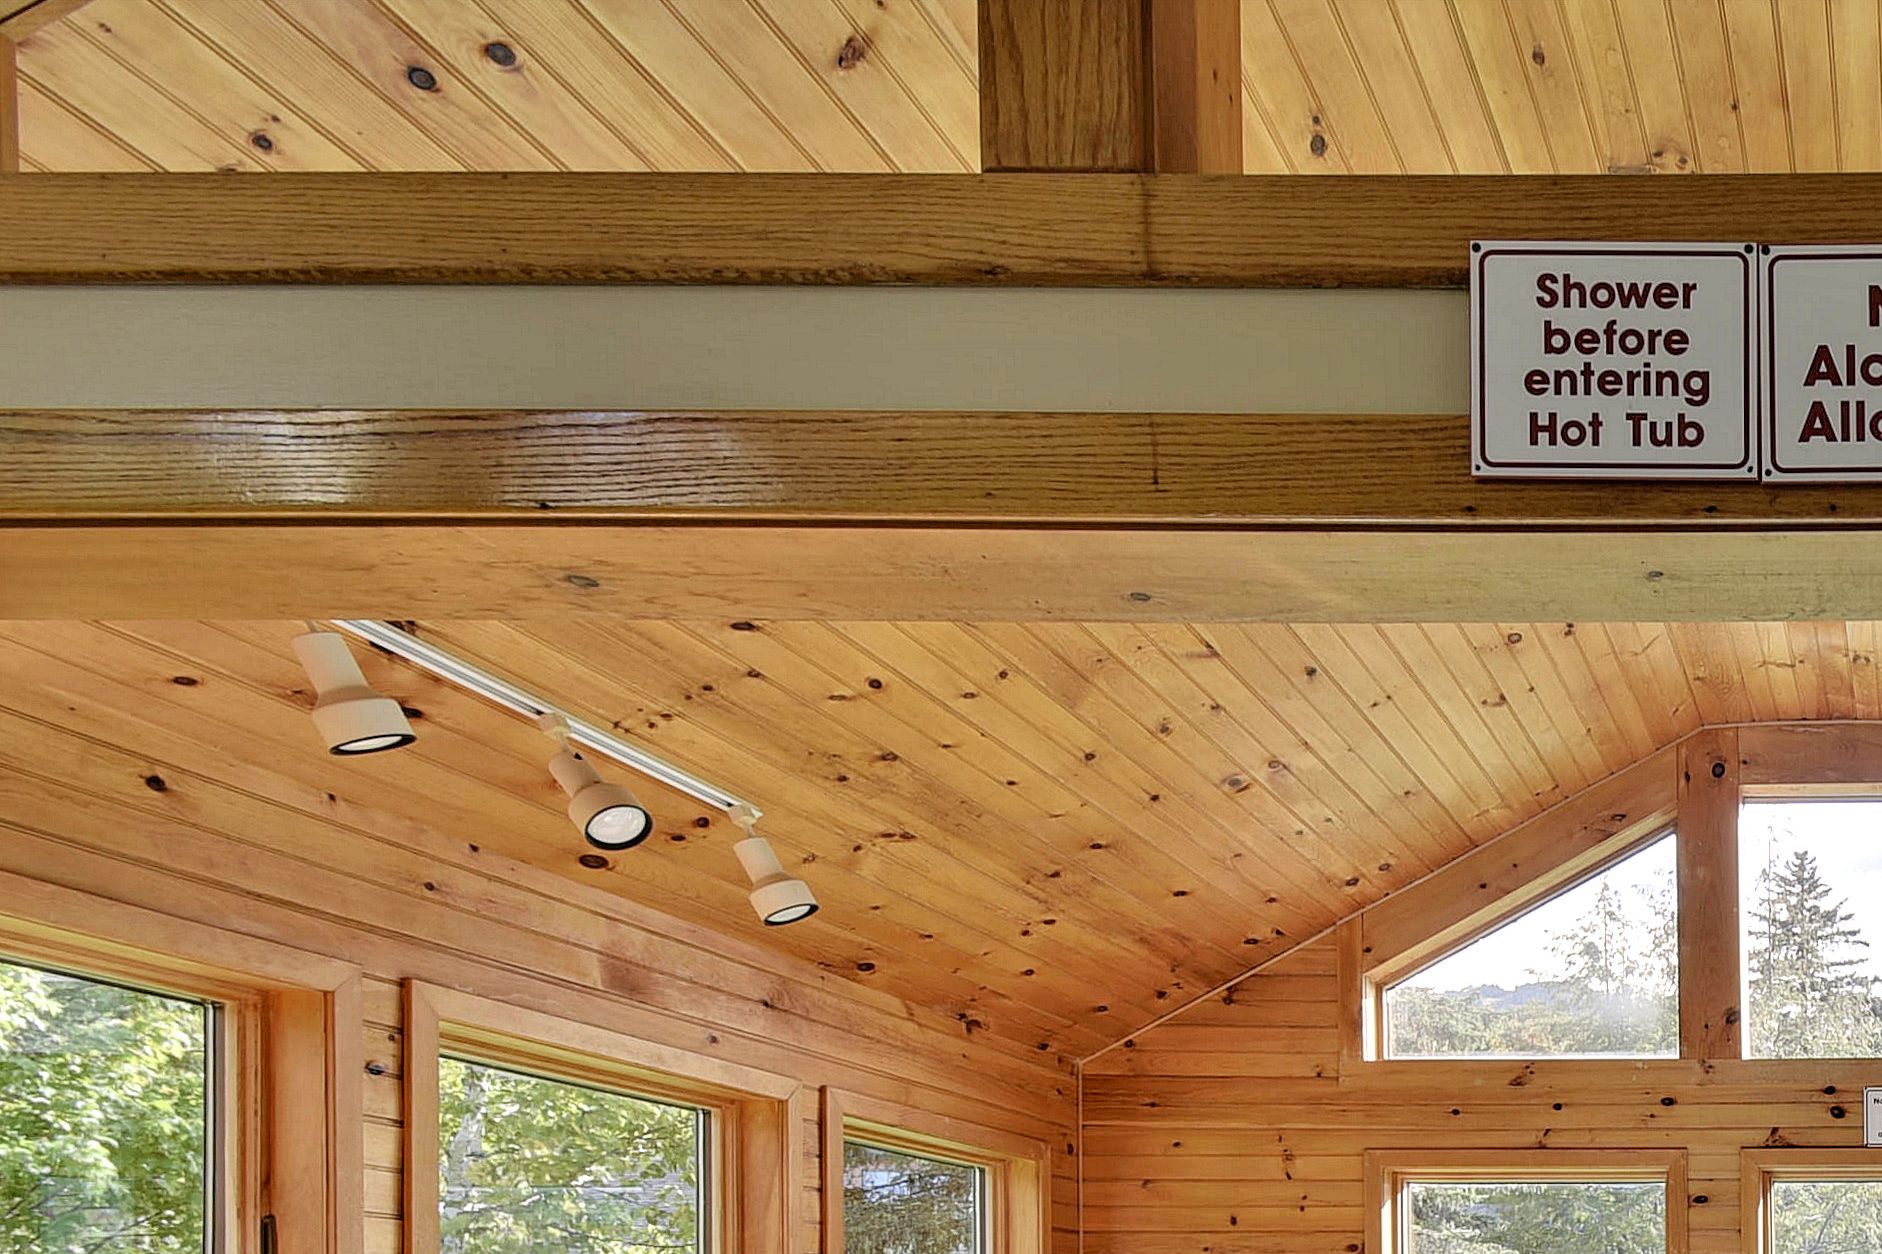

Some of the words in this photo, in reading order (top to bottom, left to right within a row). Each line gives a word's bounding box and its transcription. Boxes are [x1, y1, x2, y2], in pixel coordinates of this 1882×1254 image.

[1535, 273, 1698, 310] Shower
[1543, 320, 1690, 356] before
[1523, 362, 1711, 407] entering
[1528, 411, 1603, 447] Hot
[1625, 412, 1705, 447] Tub
